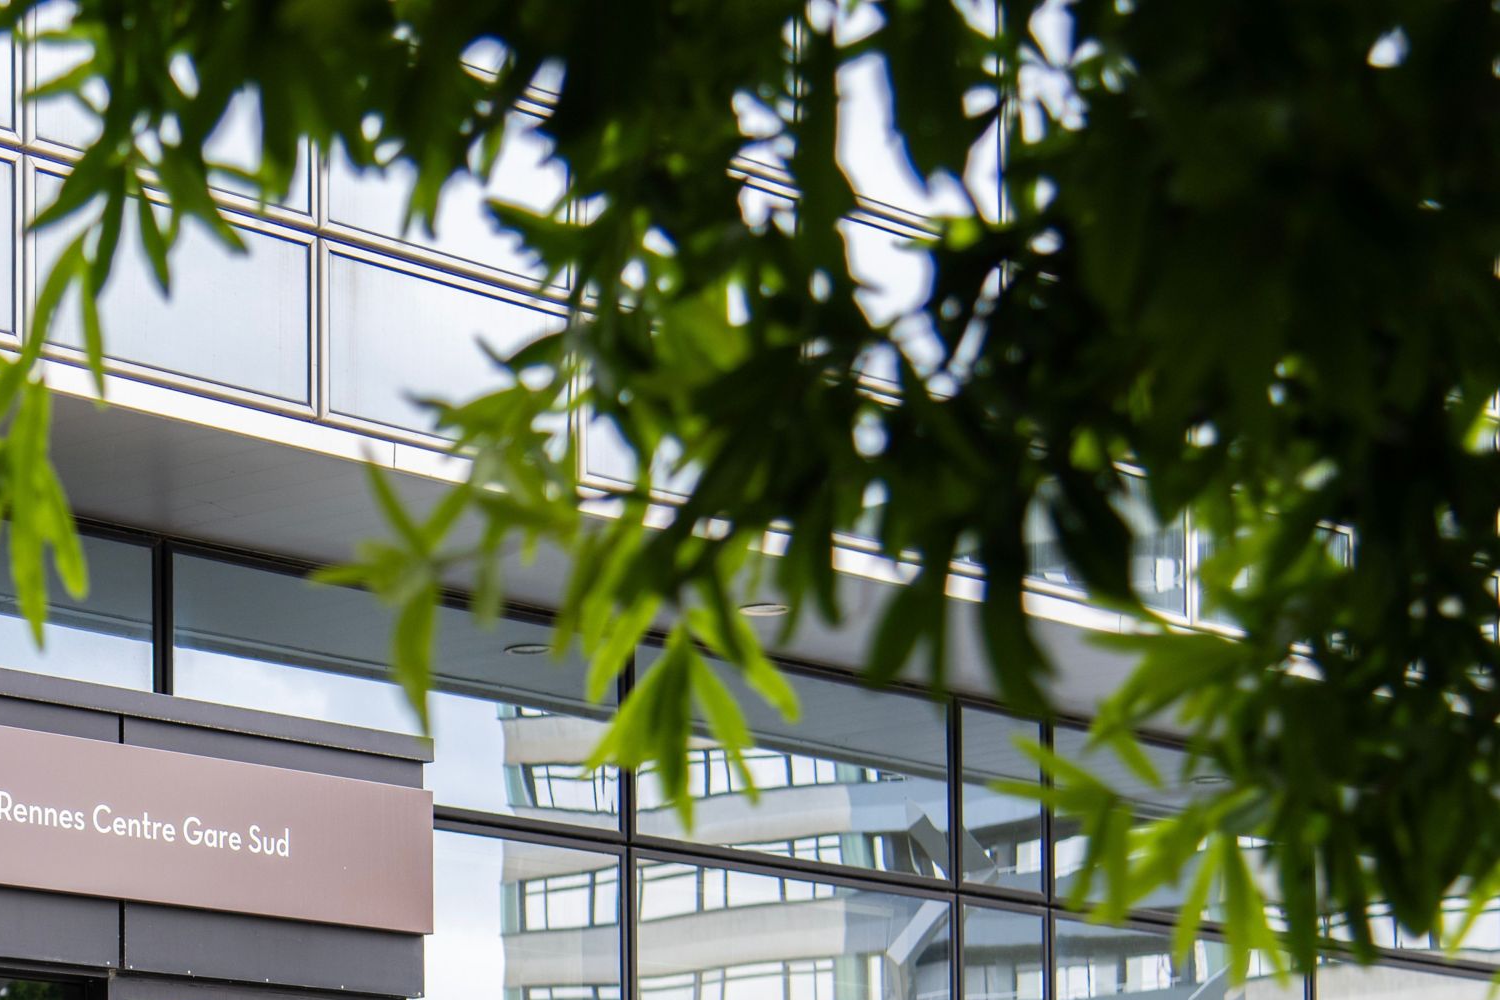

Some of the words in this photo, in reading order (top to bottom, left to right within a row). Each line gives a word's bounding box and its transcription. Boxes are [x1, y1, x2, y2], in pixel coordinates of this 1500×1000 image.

[92, 804, 176, 842] Centre
[183, 816, 242, 851] Gare
[248, 825, 290, 857] Sud
